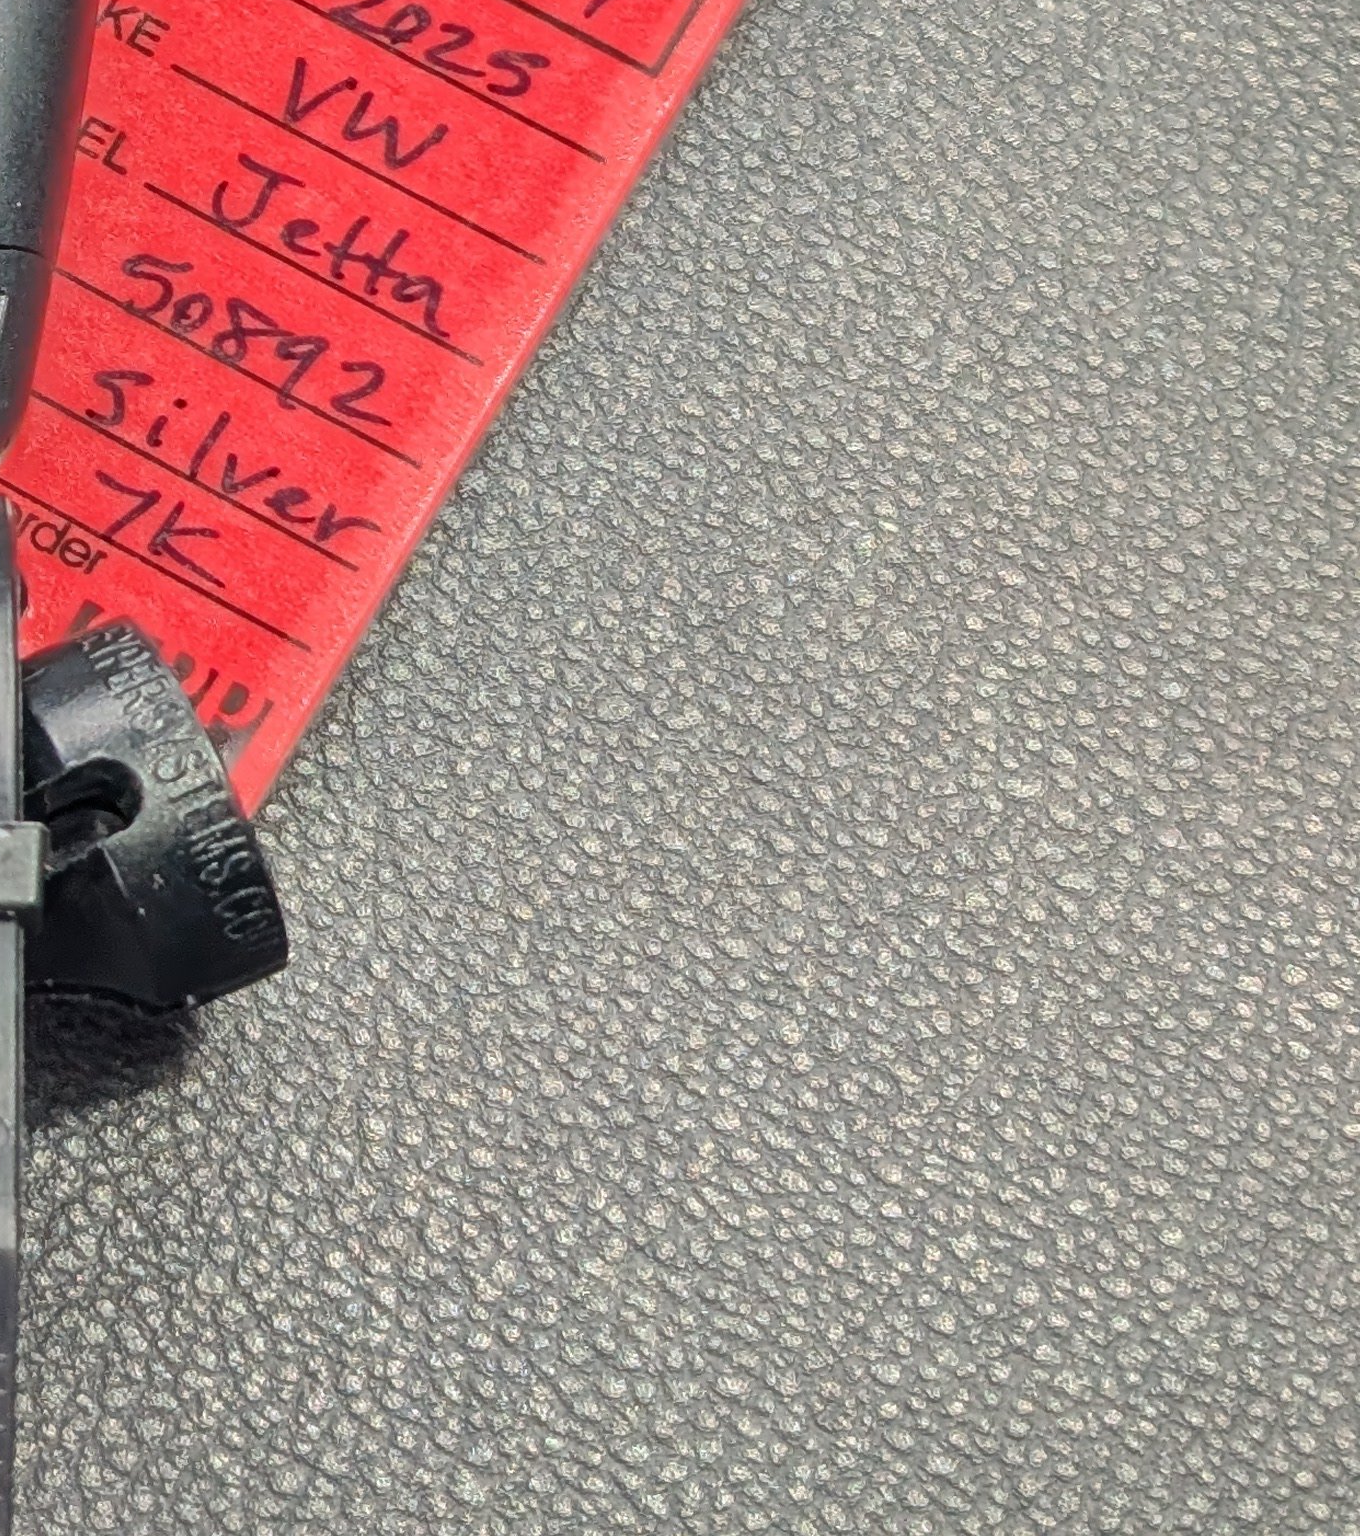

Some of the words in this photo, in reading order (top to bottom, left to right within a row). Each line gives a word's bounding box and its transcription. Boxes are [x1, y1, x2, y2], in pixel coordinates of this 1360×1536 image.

[284, 57, 448, 167] VW
[211, 153, 450, 337] Jetta
[120, 254, 392, 427] 50892
[85, 369, 383, 542] Silver
